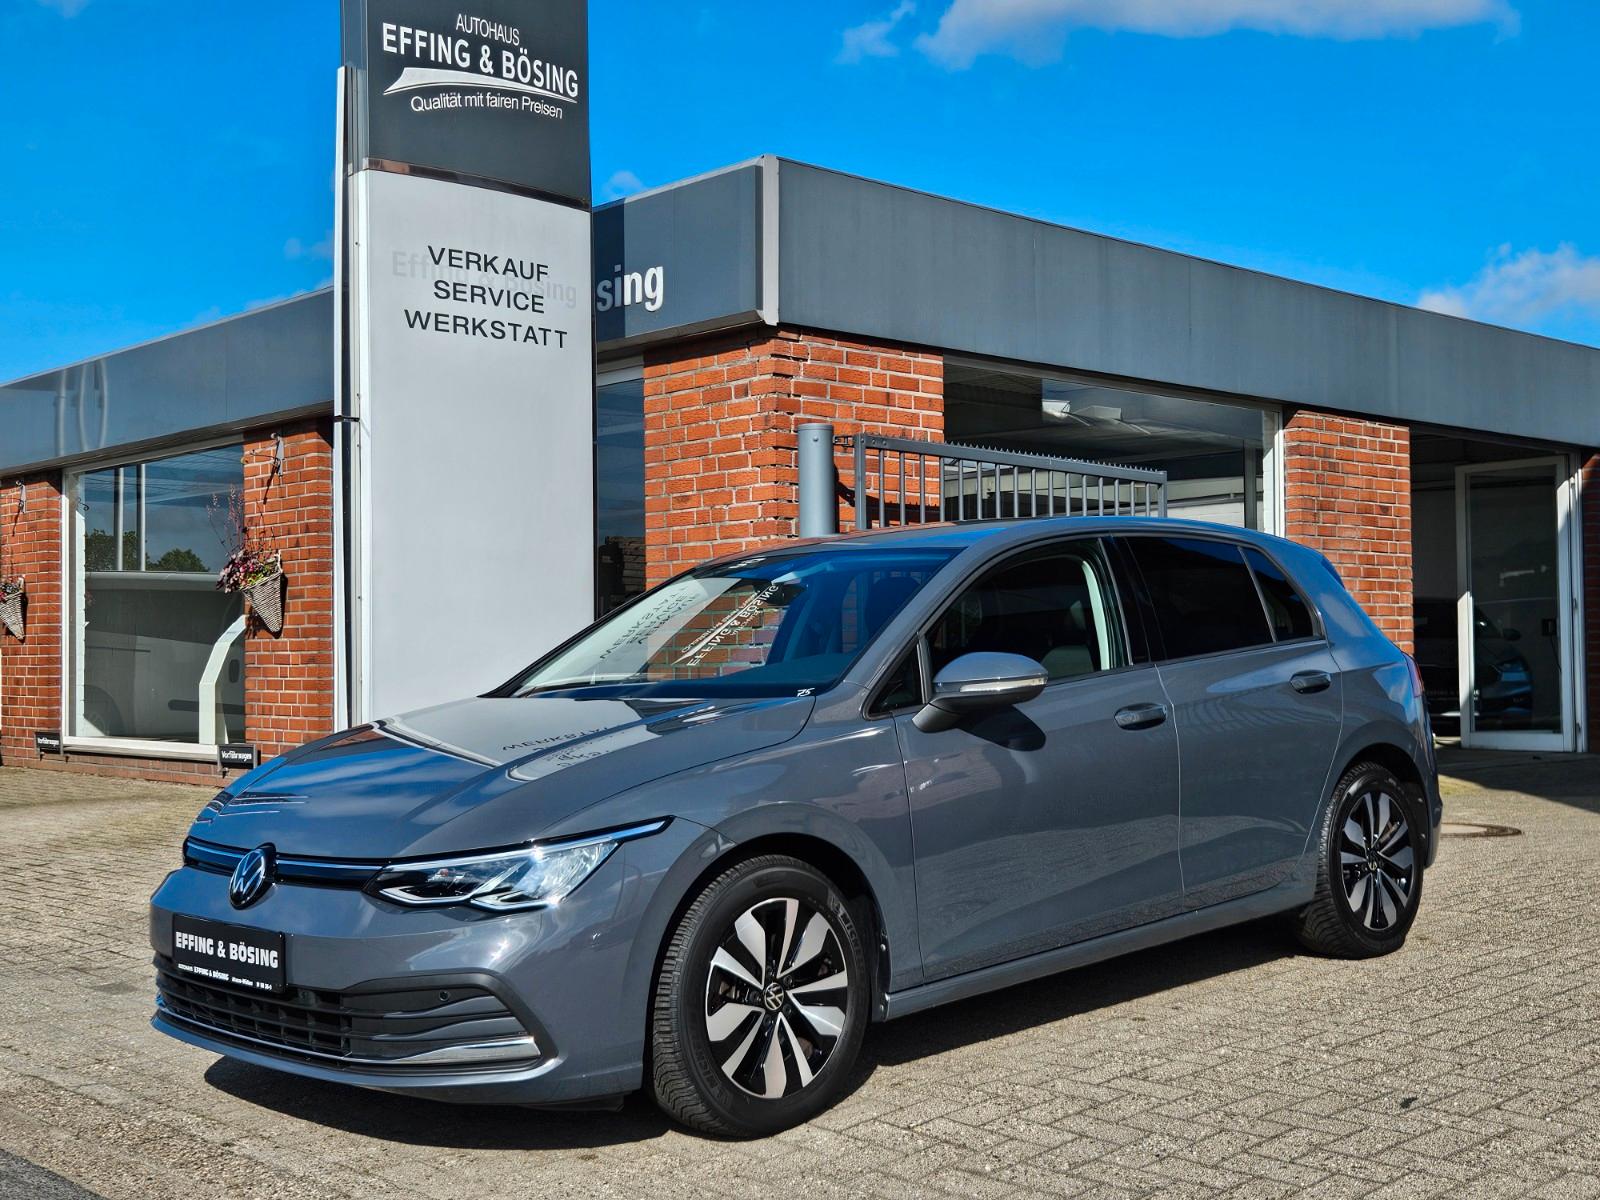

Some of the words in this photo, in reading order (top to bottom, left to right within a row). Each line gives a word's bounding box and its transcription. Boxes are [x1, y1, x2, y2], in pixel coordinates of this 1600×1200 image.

[455, 13, 520, 46] AUTOHAUS
[382, 22, 471, 68] EFFING
[479, 45, 495, 74] &
[502, 47, 579, 98] BÖSING
[410, 92, 463, 112] Qualität
[464, 93, 484, 108] mit
[486, 92, 519, 110] fairen
[521, 95, 563, 119] Preisen
[427, 245, 550, 282] VERKAUF
[433, 279, 546, 314] SERVICE
[596, 264, 664, 313] sing
[403, 308, 569, 349] WERKSTATT
[175, 931, 214, 956] EFFING
[217, 940, 227, 959] &
[229, 941, 279, 969] BÖSING
